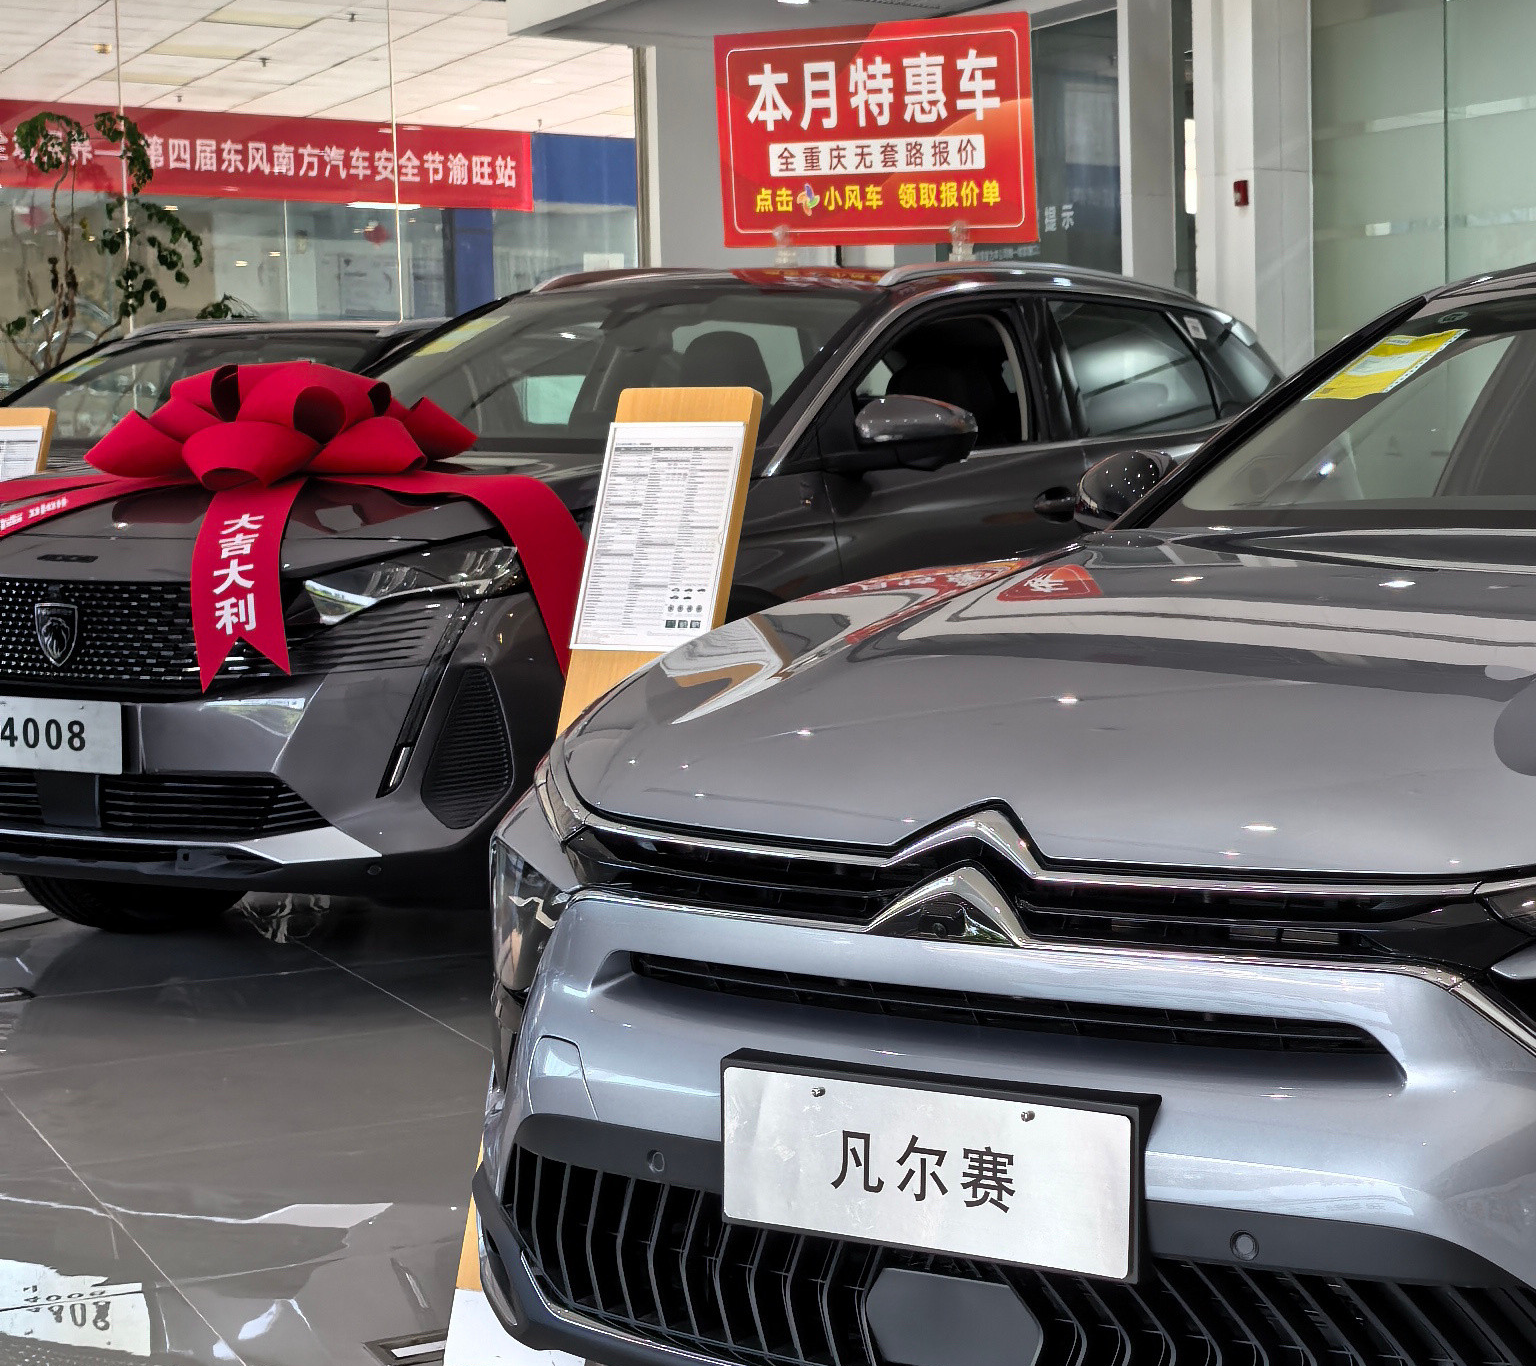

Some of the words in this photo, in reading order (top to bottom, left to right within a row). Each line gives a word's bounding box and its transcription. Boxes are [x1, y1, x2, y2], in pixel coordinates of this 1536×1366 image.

[747, 49, 1001, 132] 本月特惠车
[777, 138, 977, 173] 全重庆无套路报价
[898, 180, 1001, 209] 领取报价单
[213, 513, 264, 635] 大吉大利
[0, 717, 86, 752] 4008
[830, 1130, 1016, 1213] 凡尔赛
